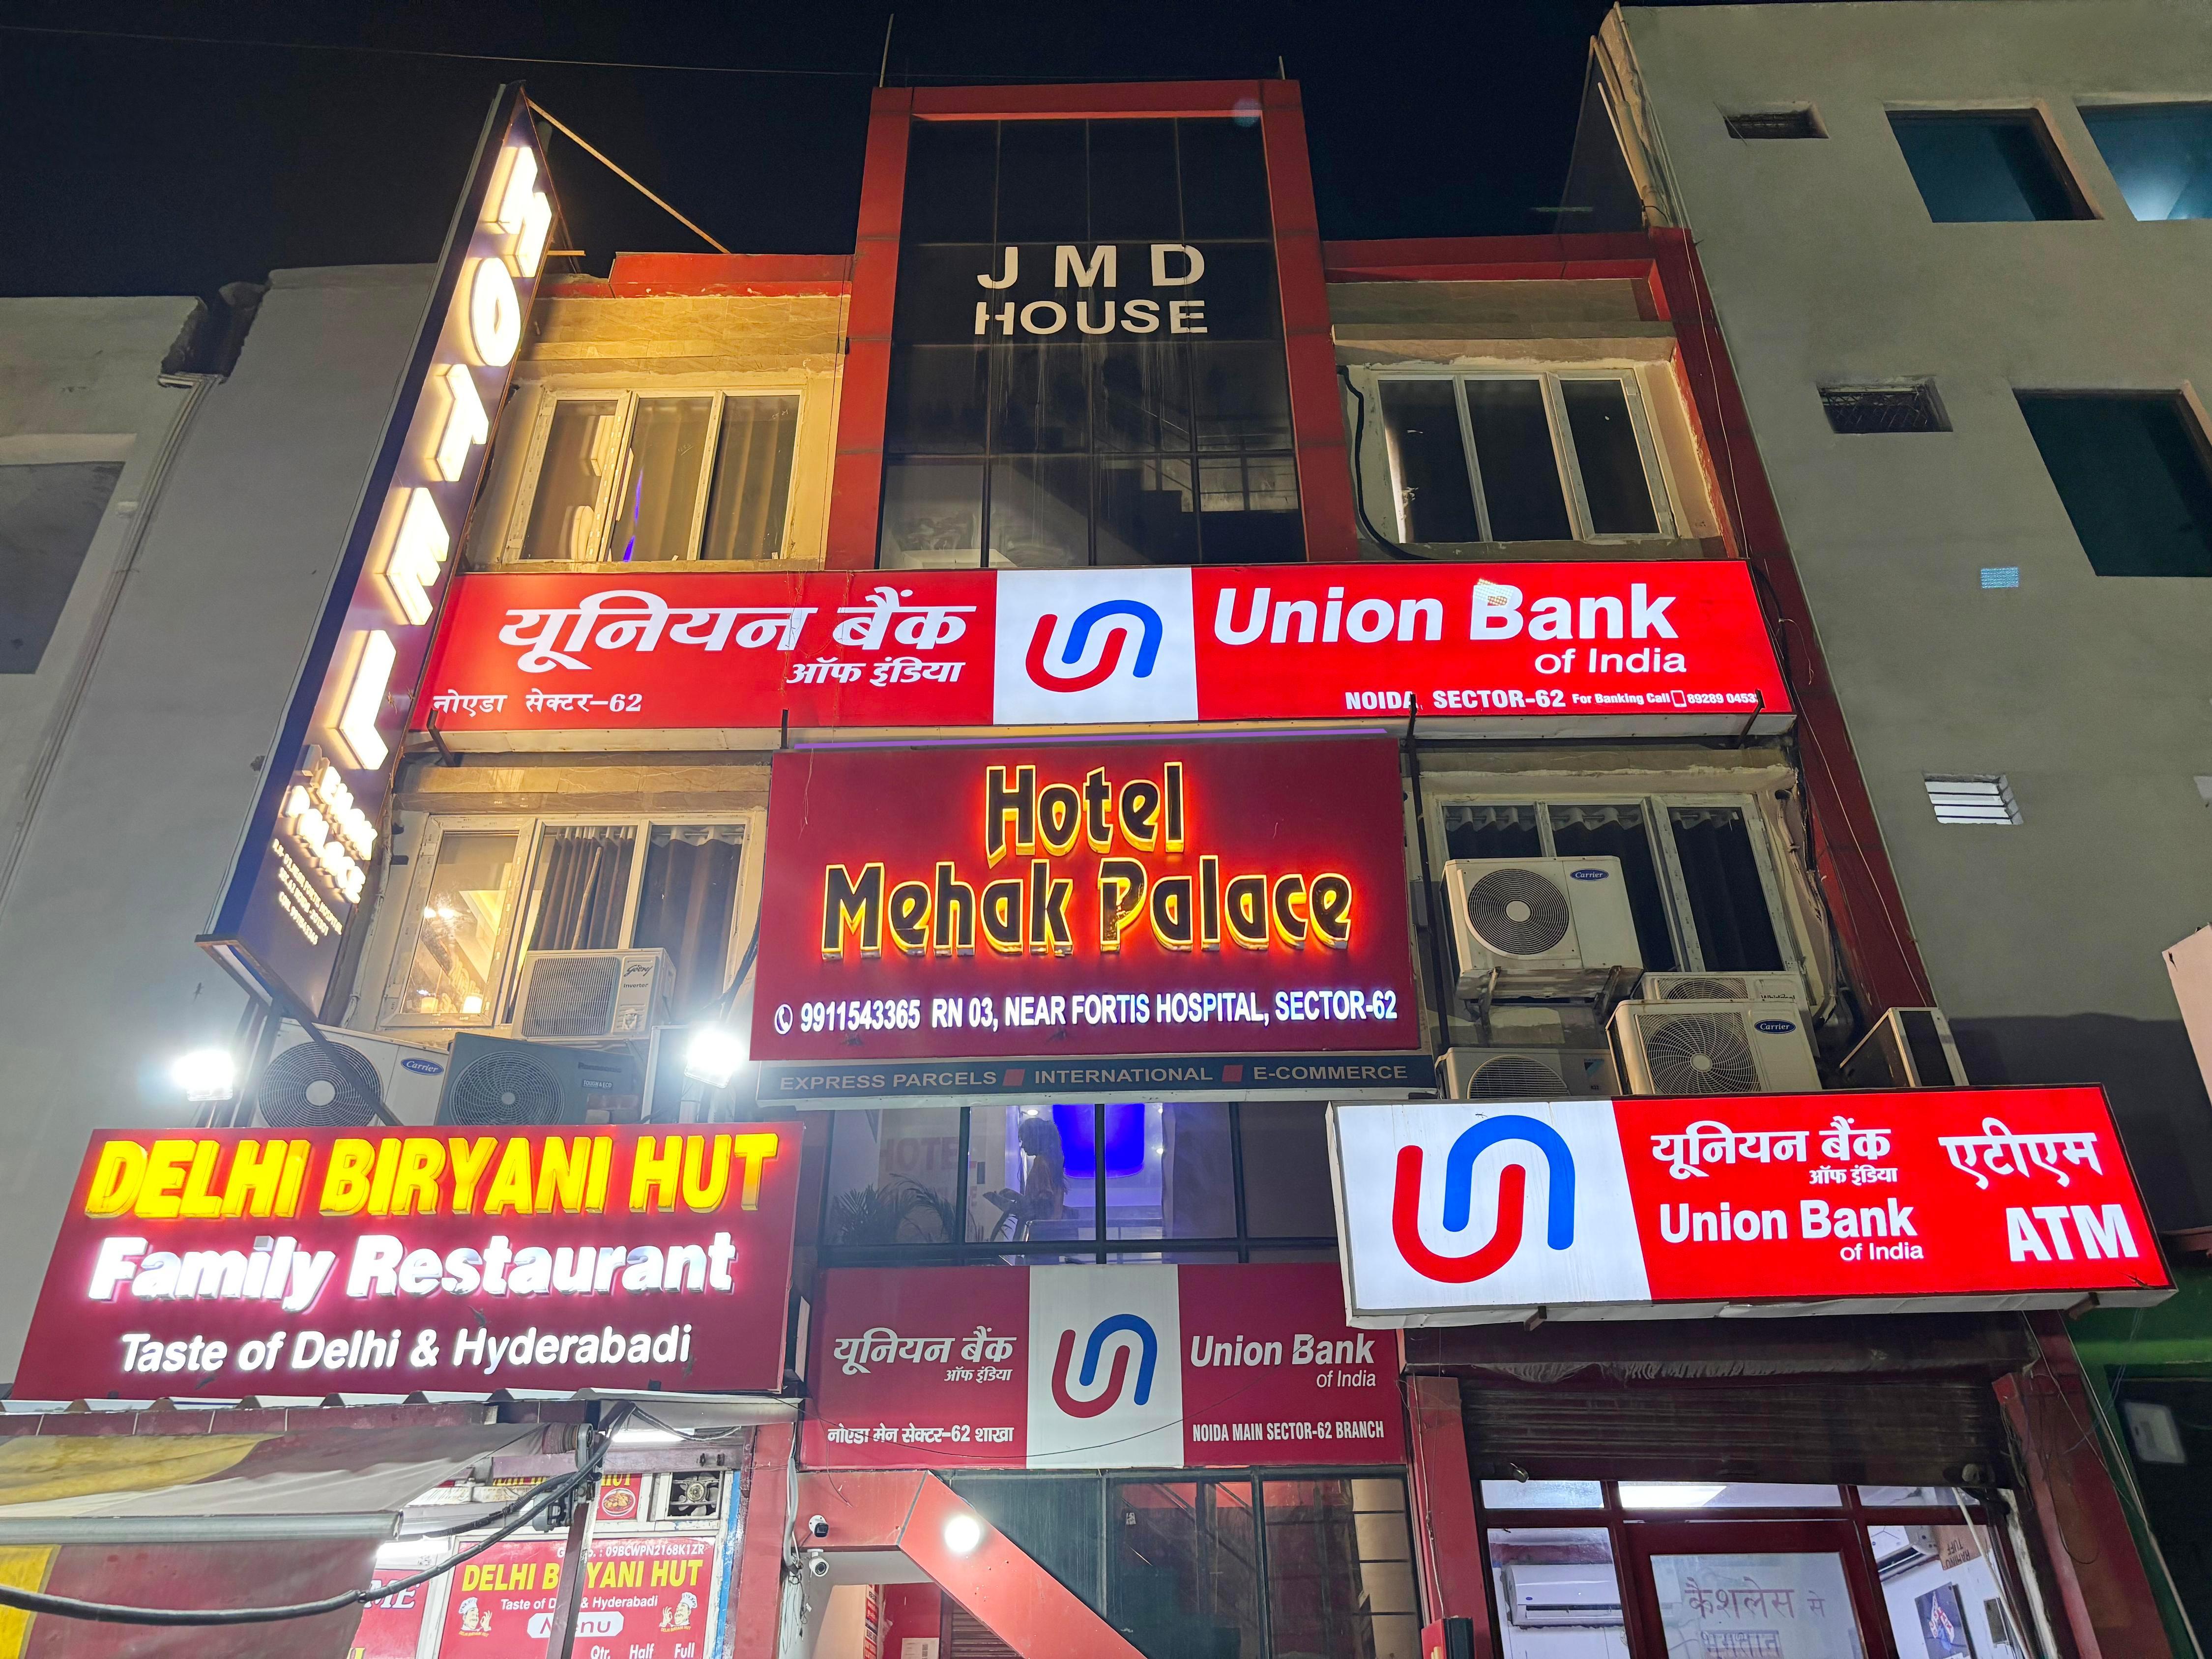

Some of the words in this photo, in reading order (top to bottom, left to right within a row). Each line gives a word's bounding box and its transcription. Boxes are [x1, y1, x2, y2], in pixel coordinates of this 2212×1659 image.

[975, 299, 1208, 335] HOUSE
[339, 146, 552, 770] HOTEL
[499, 590, 817, 672] यूनियन
[831, 586, 976, 650] बैंक
[1214, 586, 1443, 645] Union
[1470, 582, 1678, 641] Bank
[787, 657, 866, 683] ऑफ
[870, 656, 965, 686] इंडिया
[1535, 648, 1577, 674] of
[1590, 647, 1686, 673] India
[433, 689, 508, 717] नोएडा
[1432, 689, 1566, 709] SECTOR-62
[1572, 694, 1592, 704] For
[1595, 693, 1644, 705] Banking
[1646, 693, 1671, 703] Call
[1687, 693, 1724, 703] 89289
[1726, 693, 1759, 703] 0453
[985, 761, 1185, 869] Hotel
[821, 858, 1074, 960] Mehak
[1099, 855, 1352, 952] Palace
[801, 999, 920, 1032] 9911543365
[932, 998, 963, 1028] RN
[969, 997, 998, 1032] 03,
[1005, 995, 1066, 1027] NEAR
[1072, 992, 1150, 1025] FORTIS
[1157, 991, 1269, 1026] HOSPITAL,
[1275, 990, 1398, 1020] SECTOR-62
[407, 1061, 438, 1073] Carrier
[780, 1075, 885, 1090] EXPRESS
[893, 1071, 996, 1087] PARCELS
[1035, 1067, 1213, 1084] INTERNATIONAL
[1253, 1065, 1408, 1080] E-COMMERCE
[1651, 1120, 1809, 1180] यूनियन
[1819, 1115, 1892, 1161] बैंक
[1938, 1117, 2103, 1190] एटीएम
[85, 1140, 311, 1219] DELHI
[320, 1136, 612, 1217] BIRYANI
[628, 1133, 778, 1214] HUT
[1809, 1165, 1847, 1185] ऑफ
[1850, 1164, 1898, 1186] इंडिया
[1660, 1202, 1787, 1243] Union
[1800, 1198, 1918, 1239] Bank
[2006, 1204, 2139, 1262] ATM
[1840, 1243, 1863, 1261] of
[1869, 1242, 1924, 1260] India
[88, 1236, 336, 1313] Family
[346, 1232, 737, 1297] Restaurant
[122, 1333, 228, 1372] Taste
[238, 1331, 286, 1371] of
[292, 1329, 402, 1369] Delhi
[410, 1328, 438, 1368] &
[452, 1324, 692, 1375] Hyderabadi
[834, 1327, 955, 1375] यूनियन
[960, 1325, 1017, 1363] बैंक
[1191, 1335, 1282, 1367] Union
[1292, 1333, 1375, 1365] Bank
[944, 1367, 972, 1382] ऑफ
[975, 1367, 1013, 1383] इंडिया
[1316, 1370, 1333, 1388] of
[1337, 1370, 1376, 1387] India
[827, 1423, 870, 1444] नोएडा
[975, 1427, 1014, 1442] शाखा
[1193, 1424, 1229, 1442] NOIDA
[1233, 1423, 1263, 1441] MAIN
[1267, 1421, 1333, 1440] SECTOR-62
[1336, 1421, 1385, 1439] BRANCH
[462, 1563, 537, 1591] DELHI
[542, 1560, 644, 1590] BYANI
[651, 1559, 703, 1587] HUT
[501, 1599, 530, 1610] Taste
[533, 1598, 546, 1609] of
[581, 1597, 589, 1608] &
[592, 1596, 658, 1610] Hyderabadi
[590, 1645, 611, 1659] Qtr.
[630, 1643, 655, 1659] Half
[674, 1642, 695, 1659] Full
